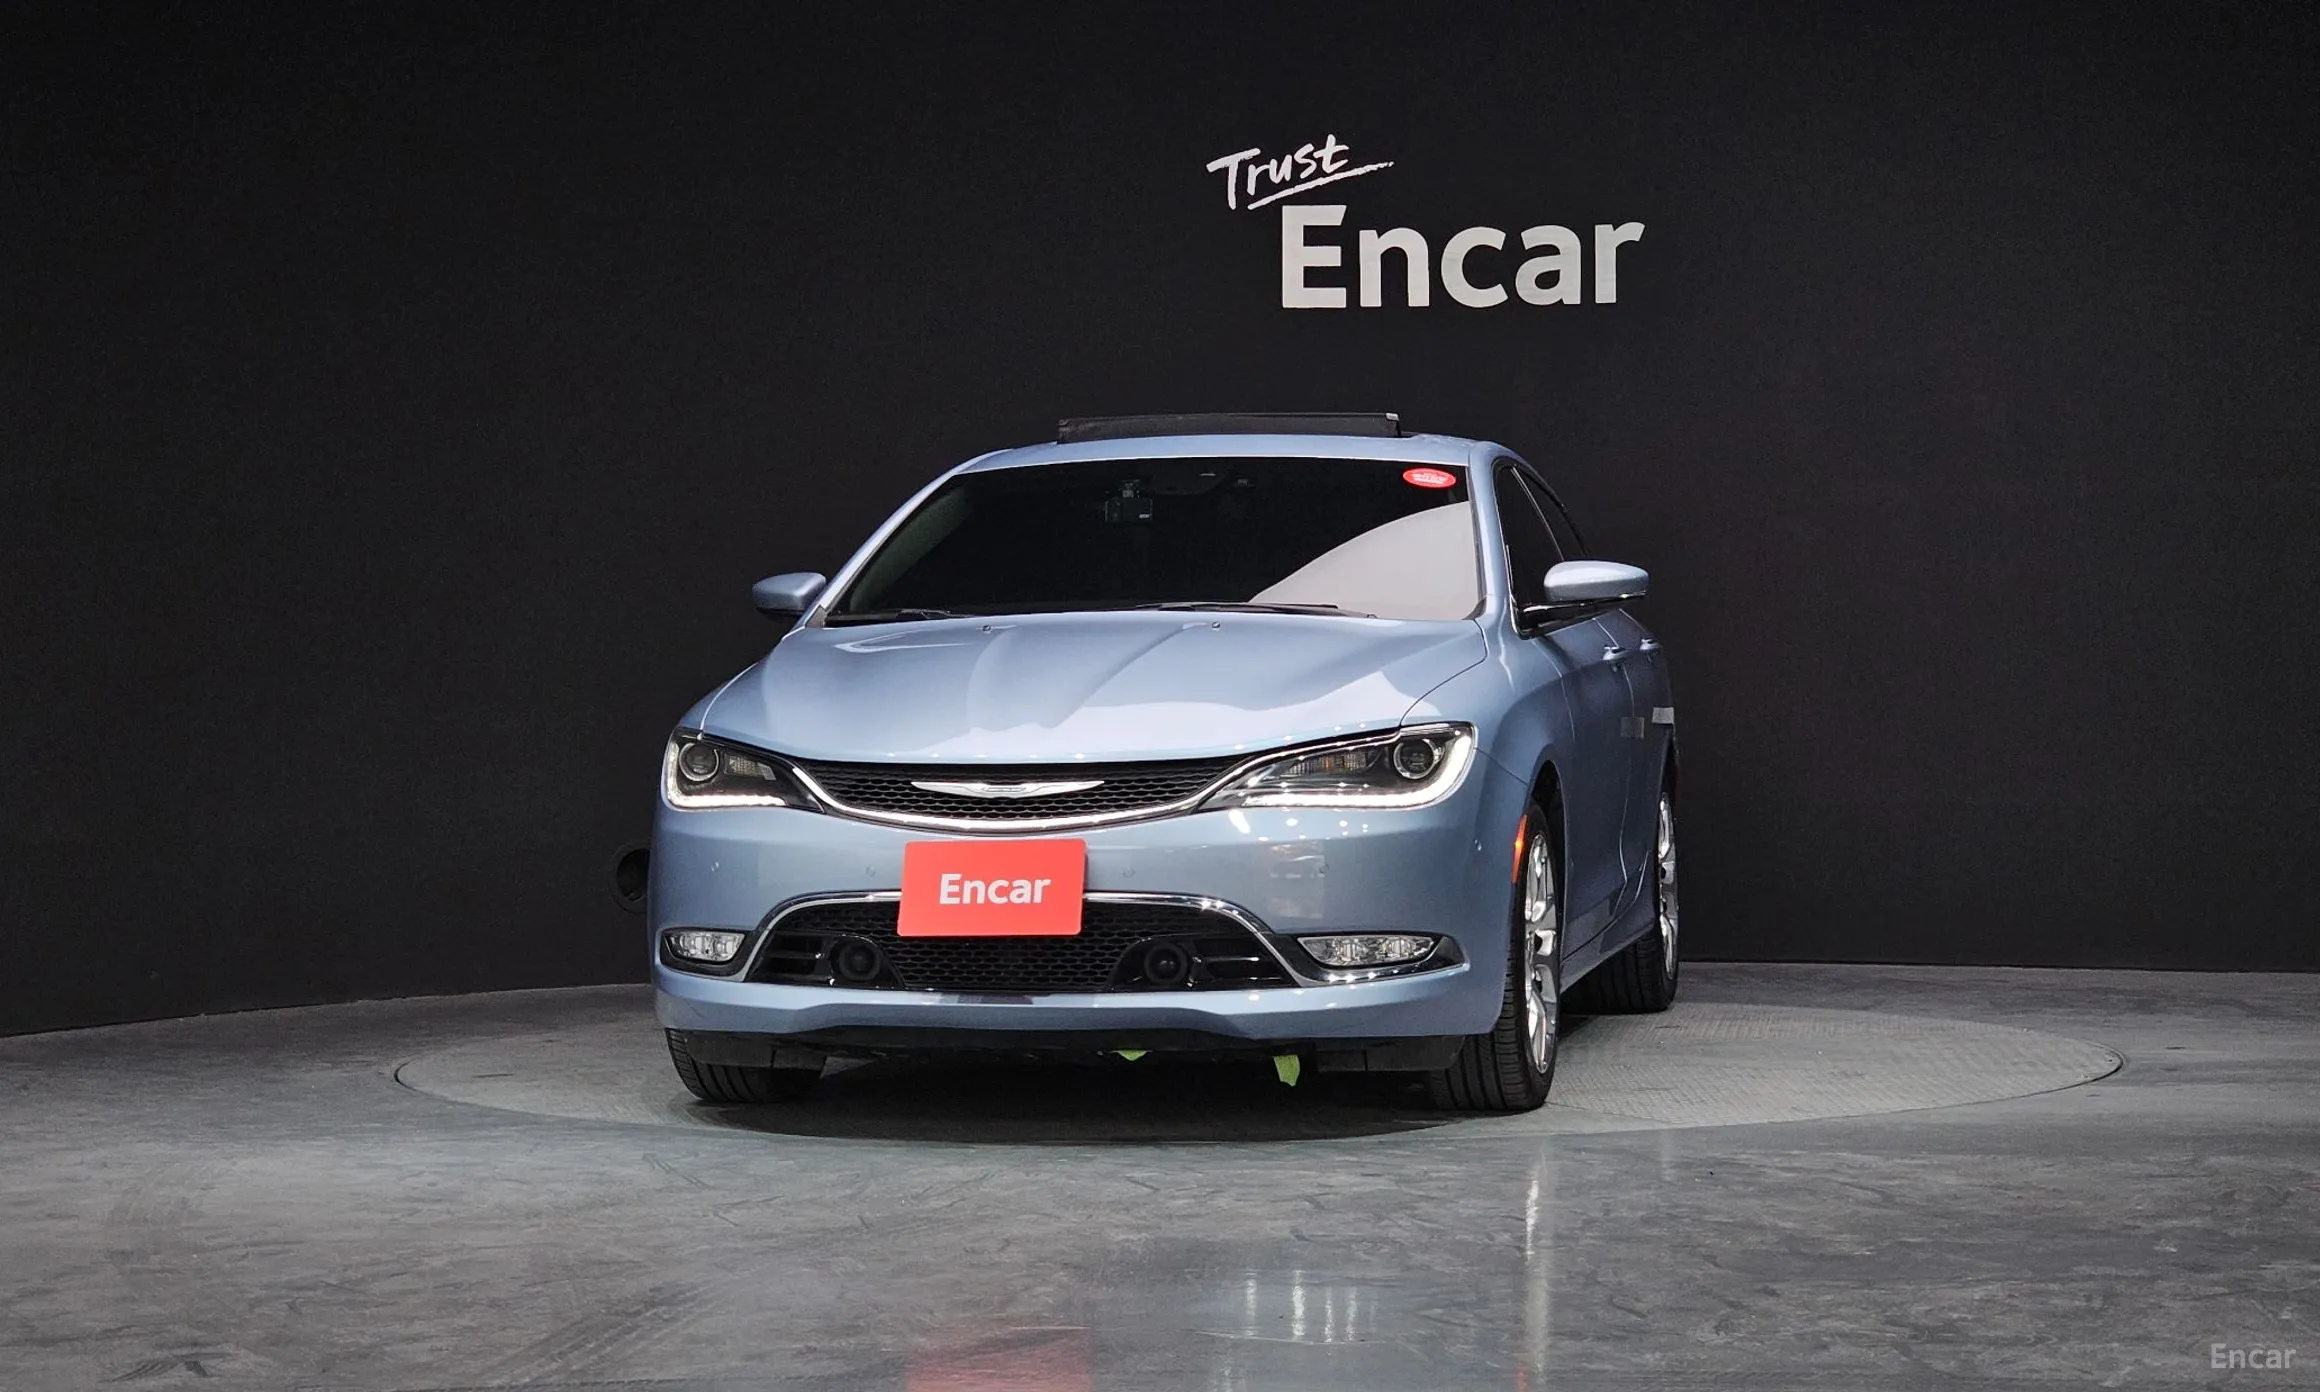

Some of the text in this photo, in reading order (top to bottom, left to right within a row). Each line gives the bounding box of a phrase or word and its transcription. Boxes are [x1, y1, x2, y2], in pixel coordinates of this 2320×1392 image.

[1206, 134, 1350, 210] Trust
[1281, 204, 1646, 309] Encar
[939, 873, 1051, 904] Encar
